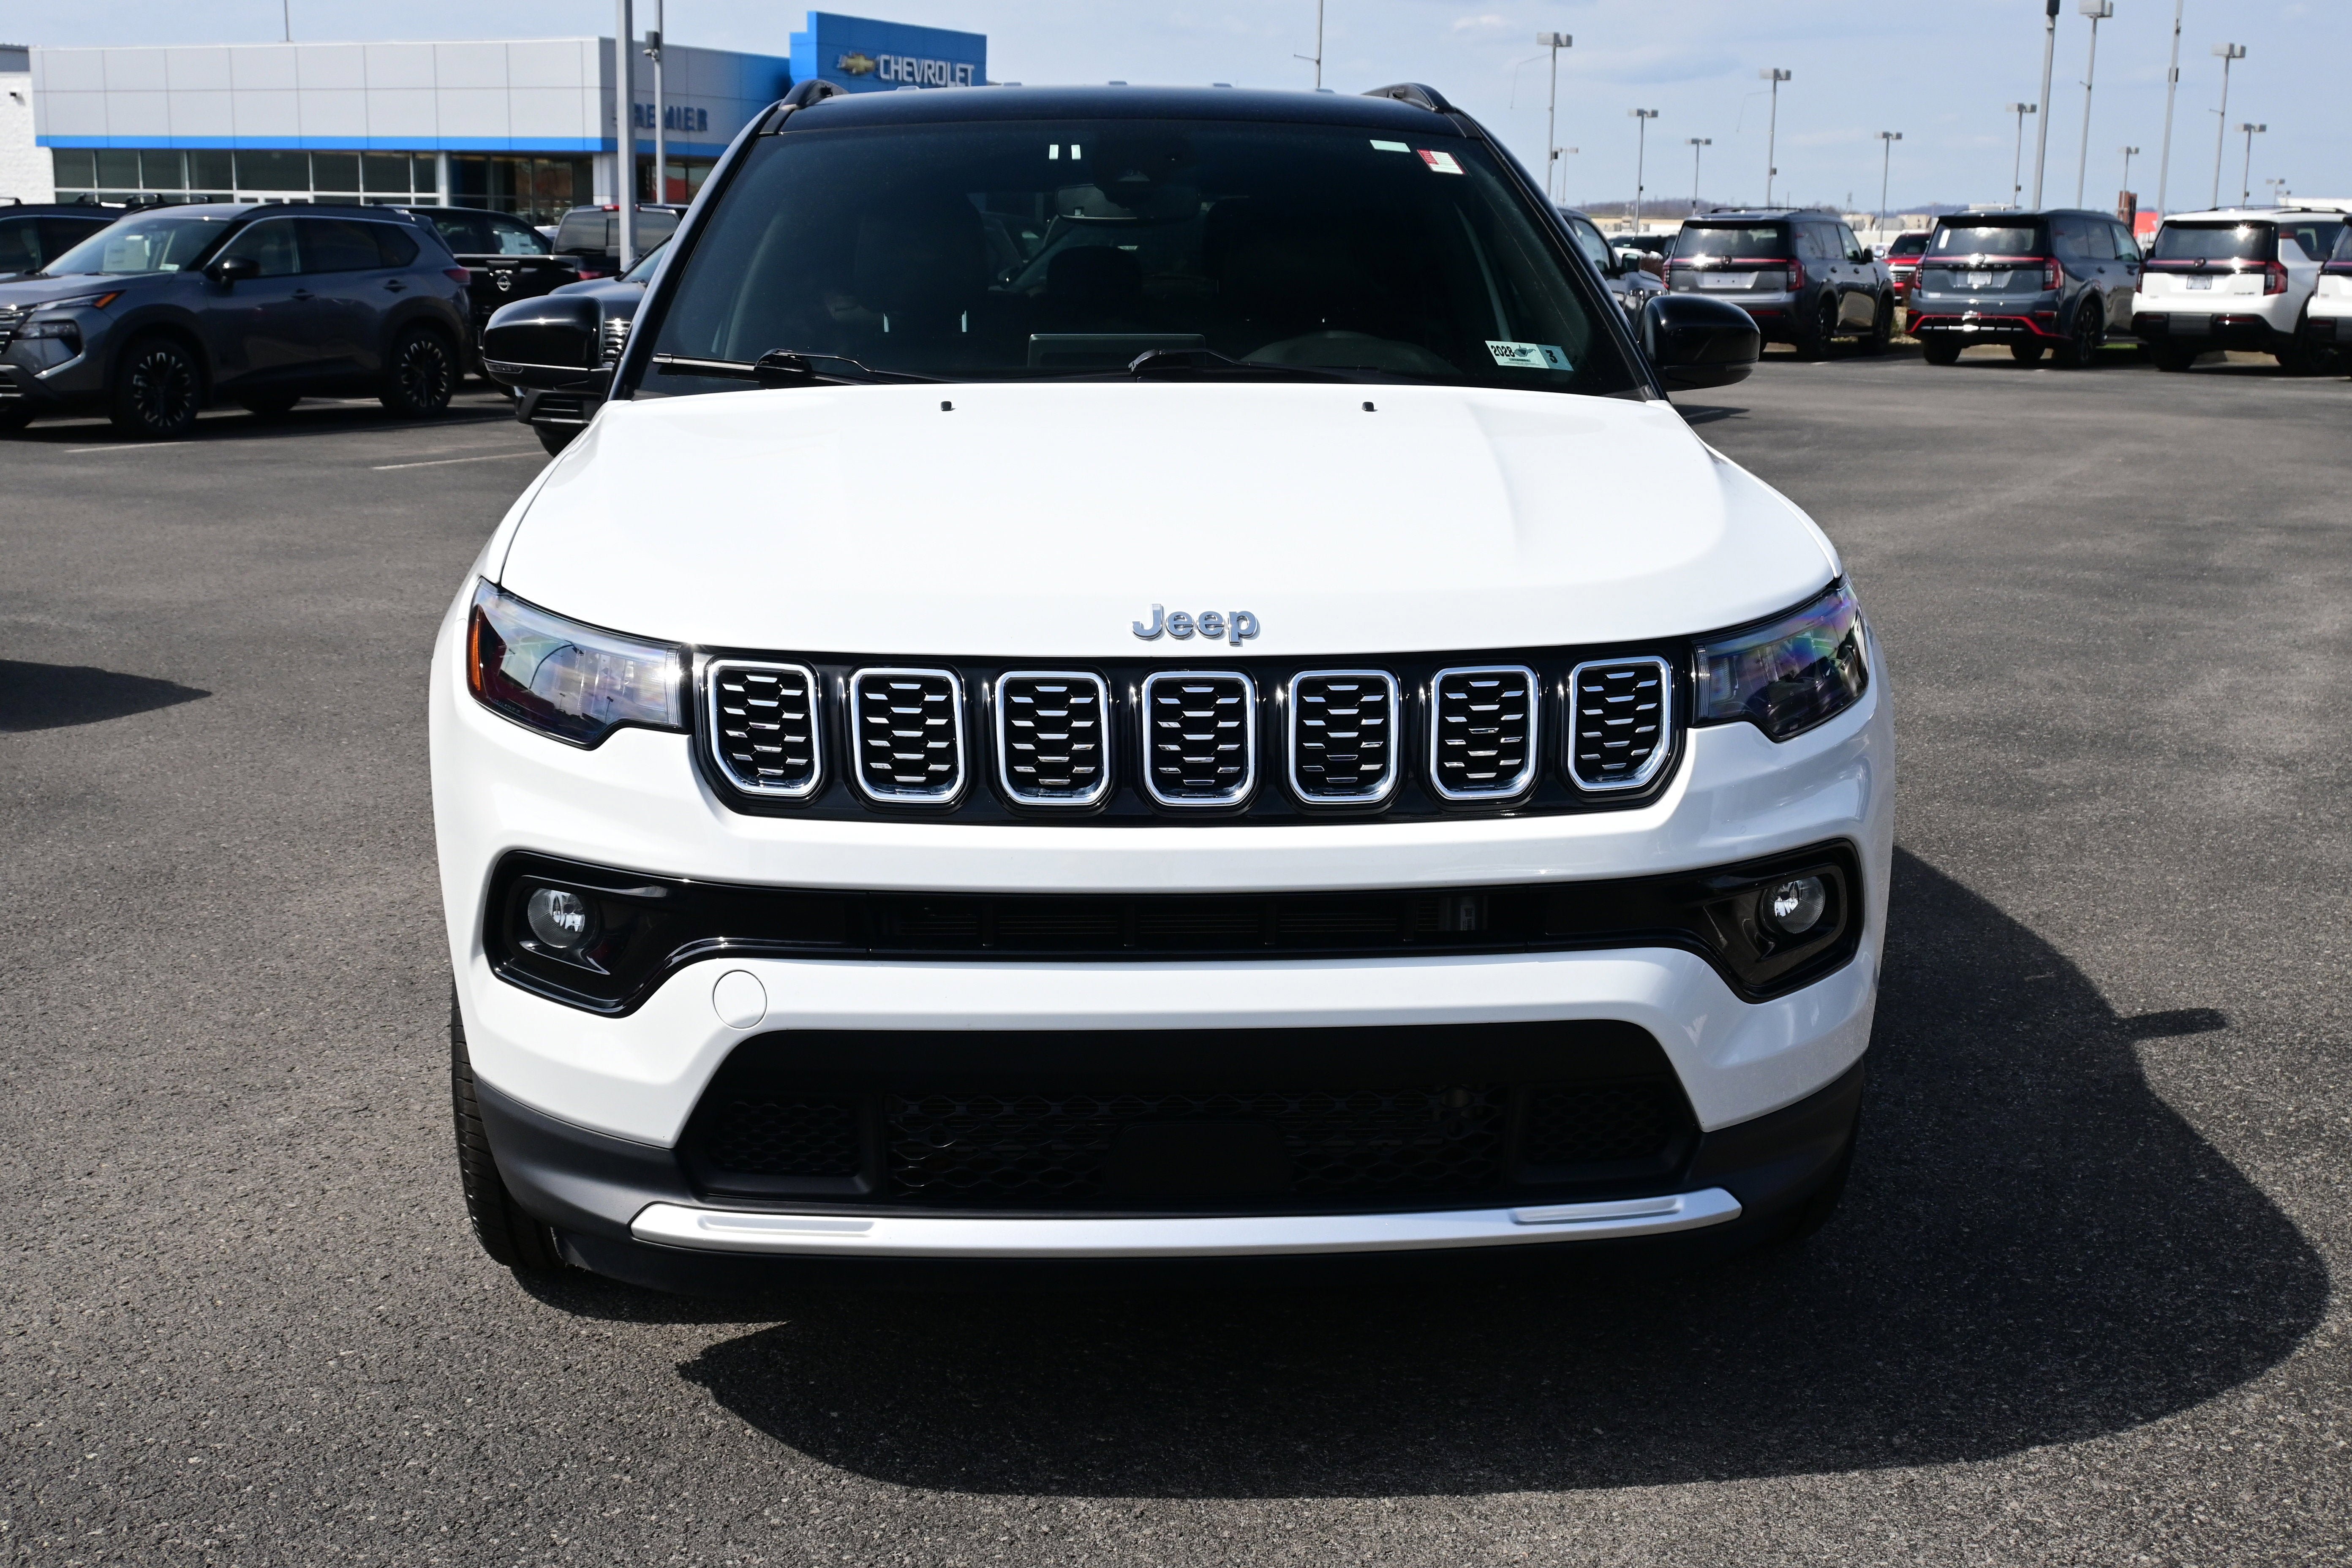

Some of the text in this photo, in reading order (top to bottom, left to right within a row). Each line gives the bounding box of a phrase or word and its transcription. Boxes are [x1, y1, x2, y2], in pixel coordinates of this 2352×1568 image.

[879, 54, 974, 87] CHEVROLET
[620, 103, 708, 131] REMIER
[1491, 345, 1558, 363] 2028 3
[1132, 604, 1258, 645] Jeep
